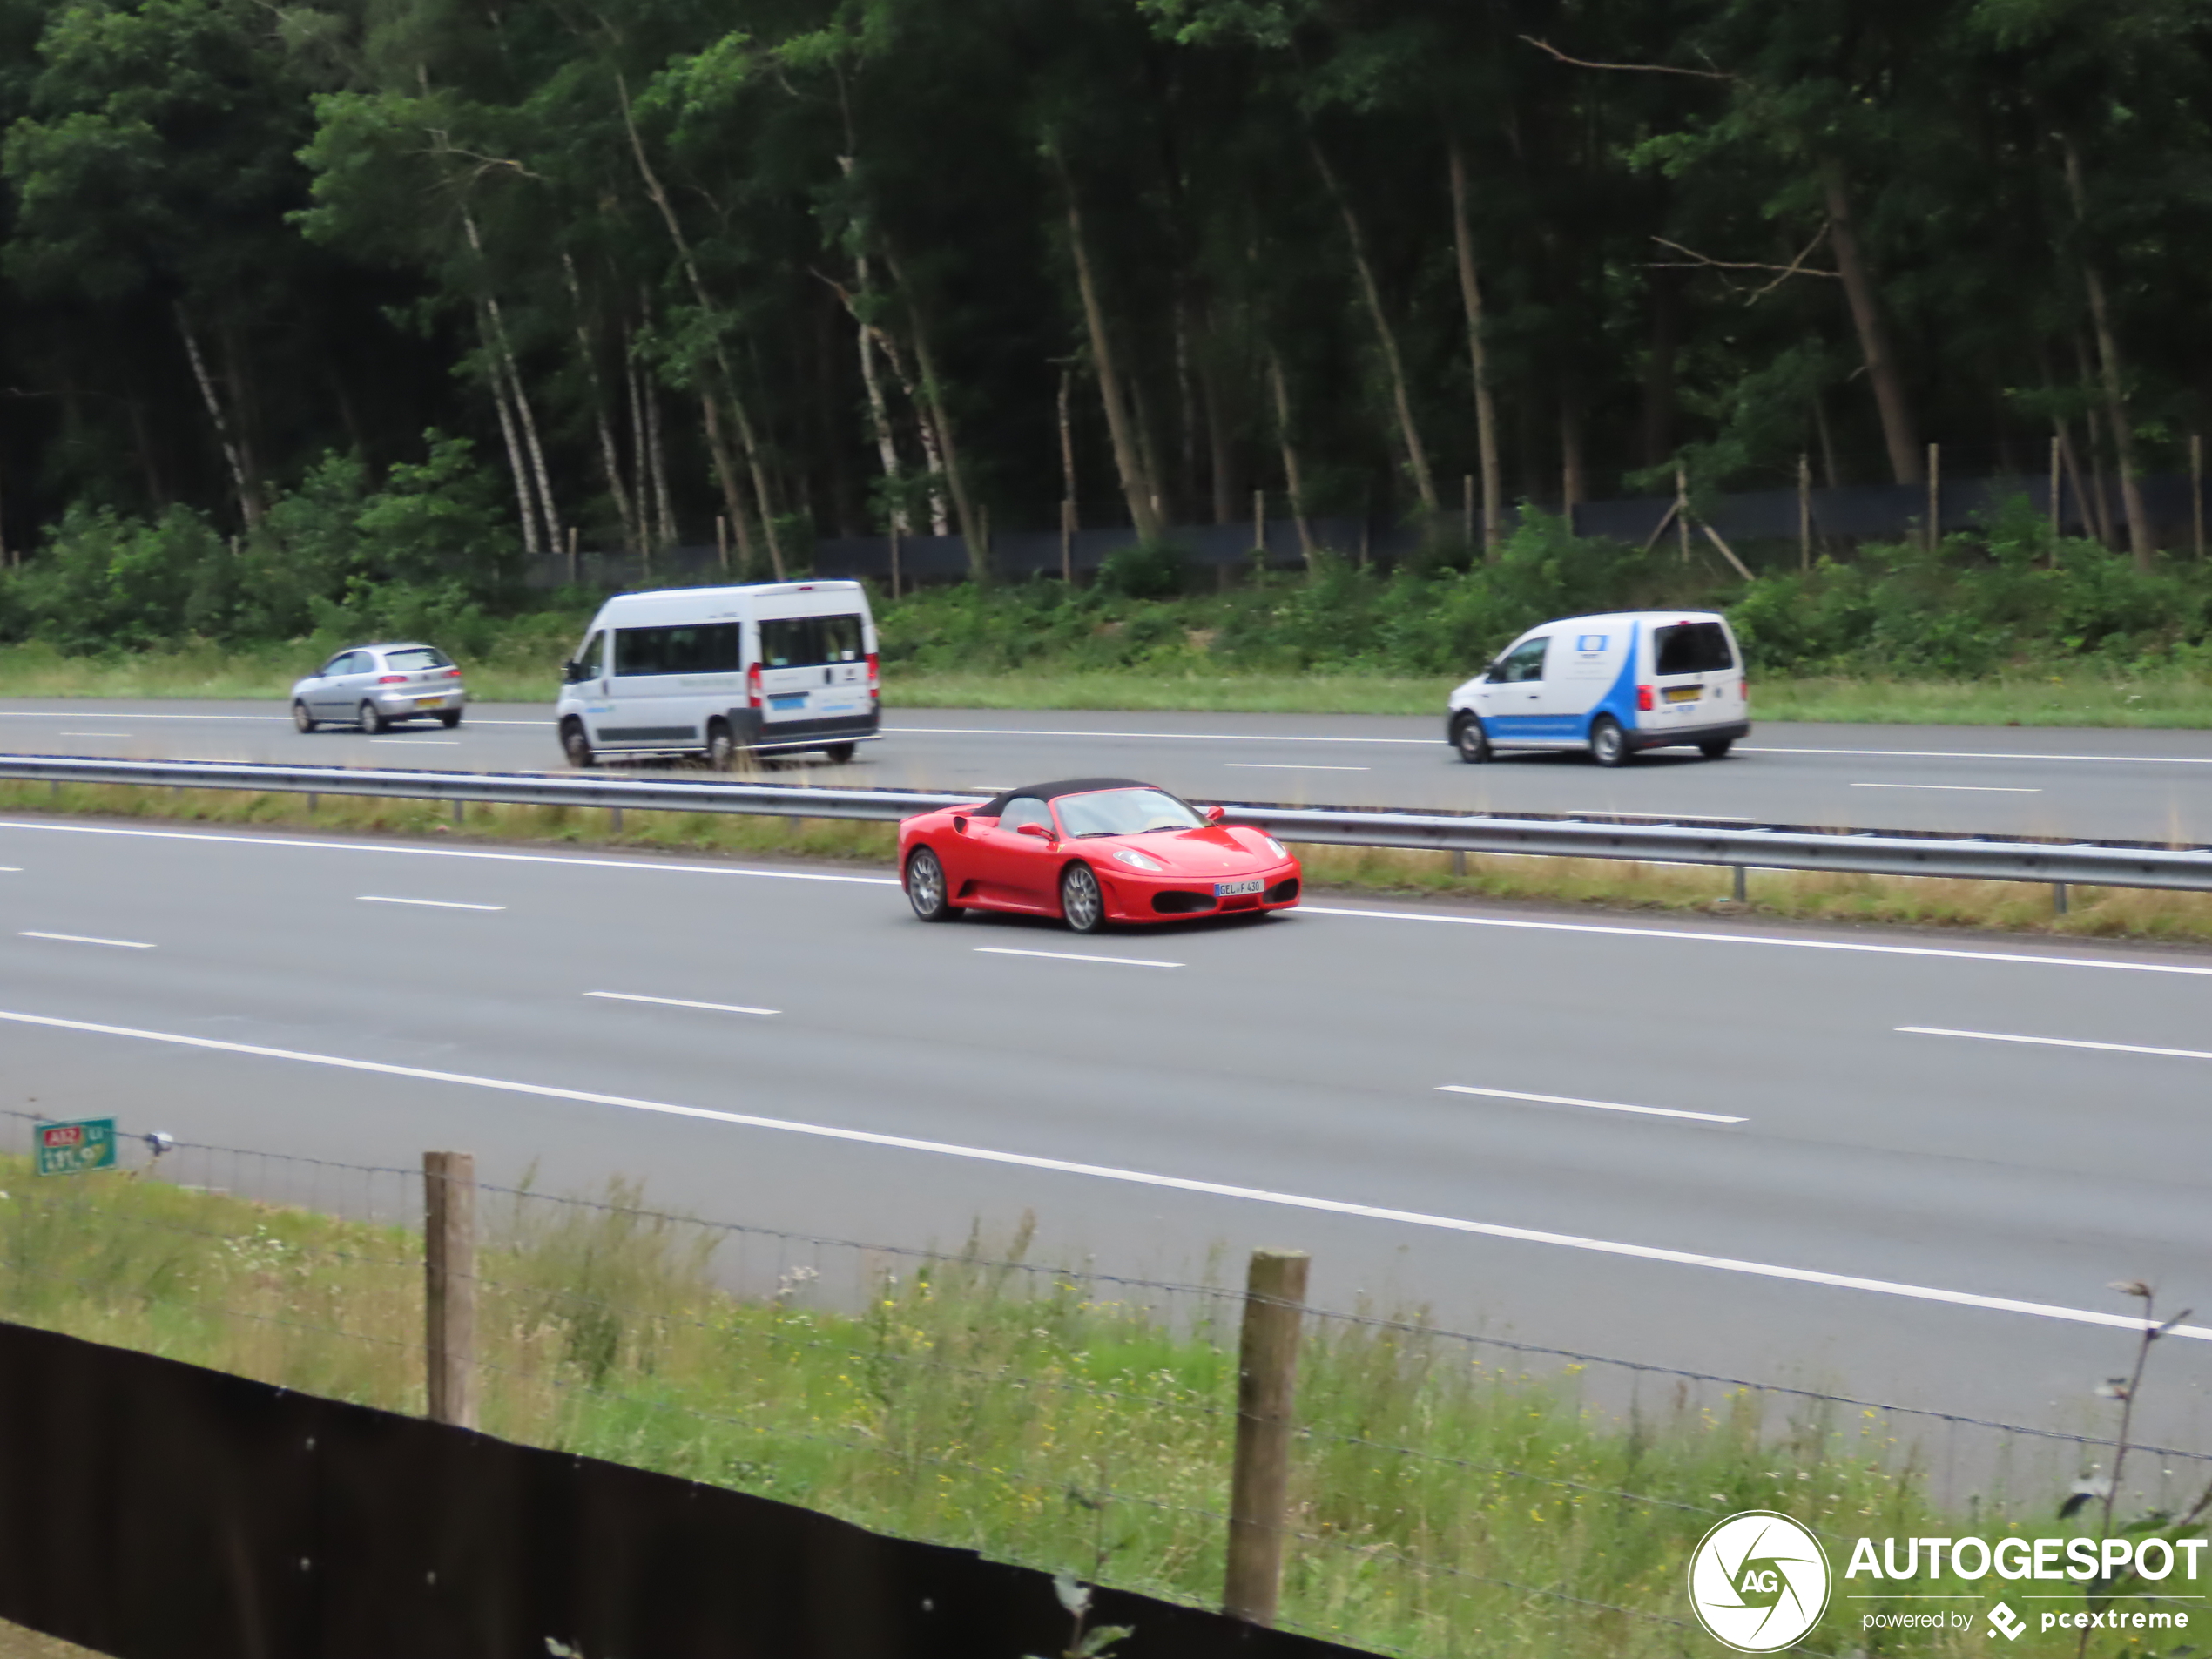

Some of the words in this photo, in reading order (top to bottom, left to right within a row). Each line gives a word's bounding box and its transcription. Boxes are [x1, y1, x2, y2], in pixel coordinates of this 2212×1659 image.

[1220, 885, 1236, 894] GEL
[1240, 883, 1245, 893] F
[1247, 881, 1260, 892] 430
